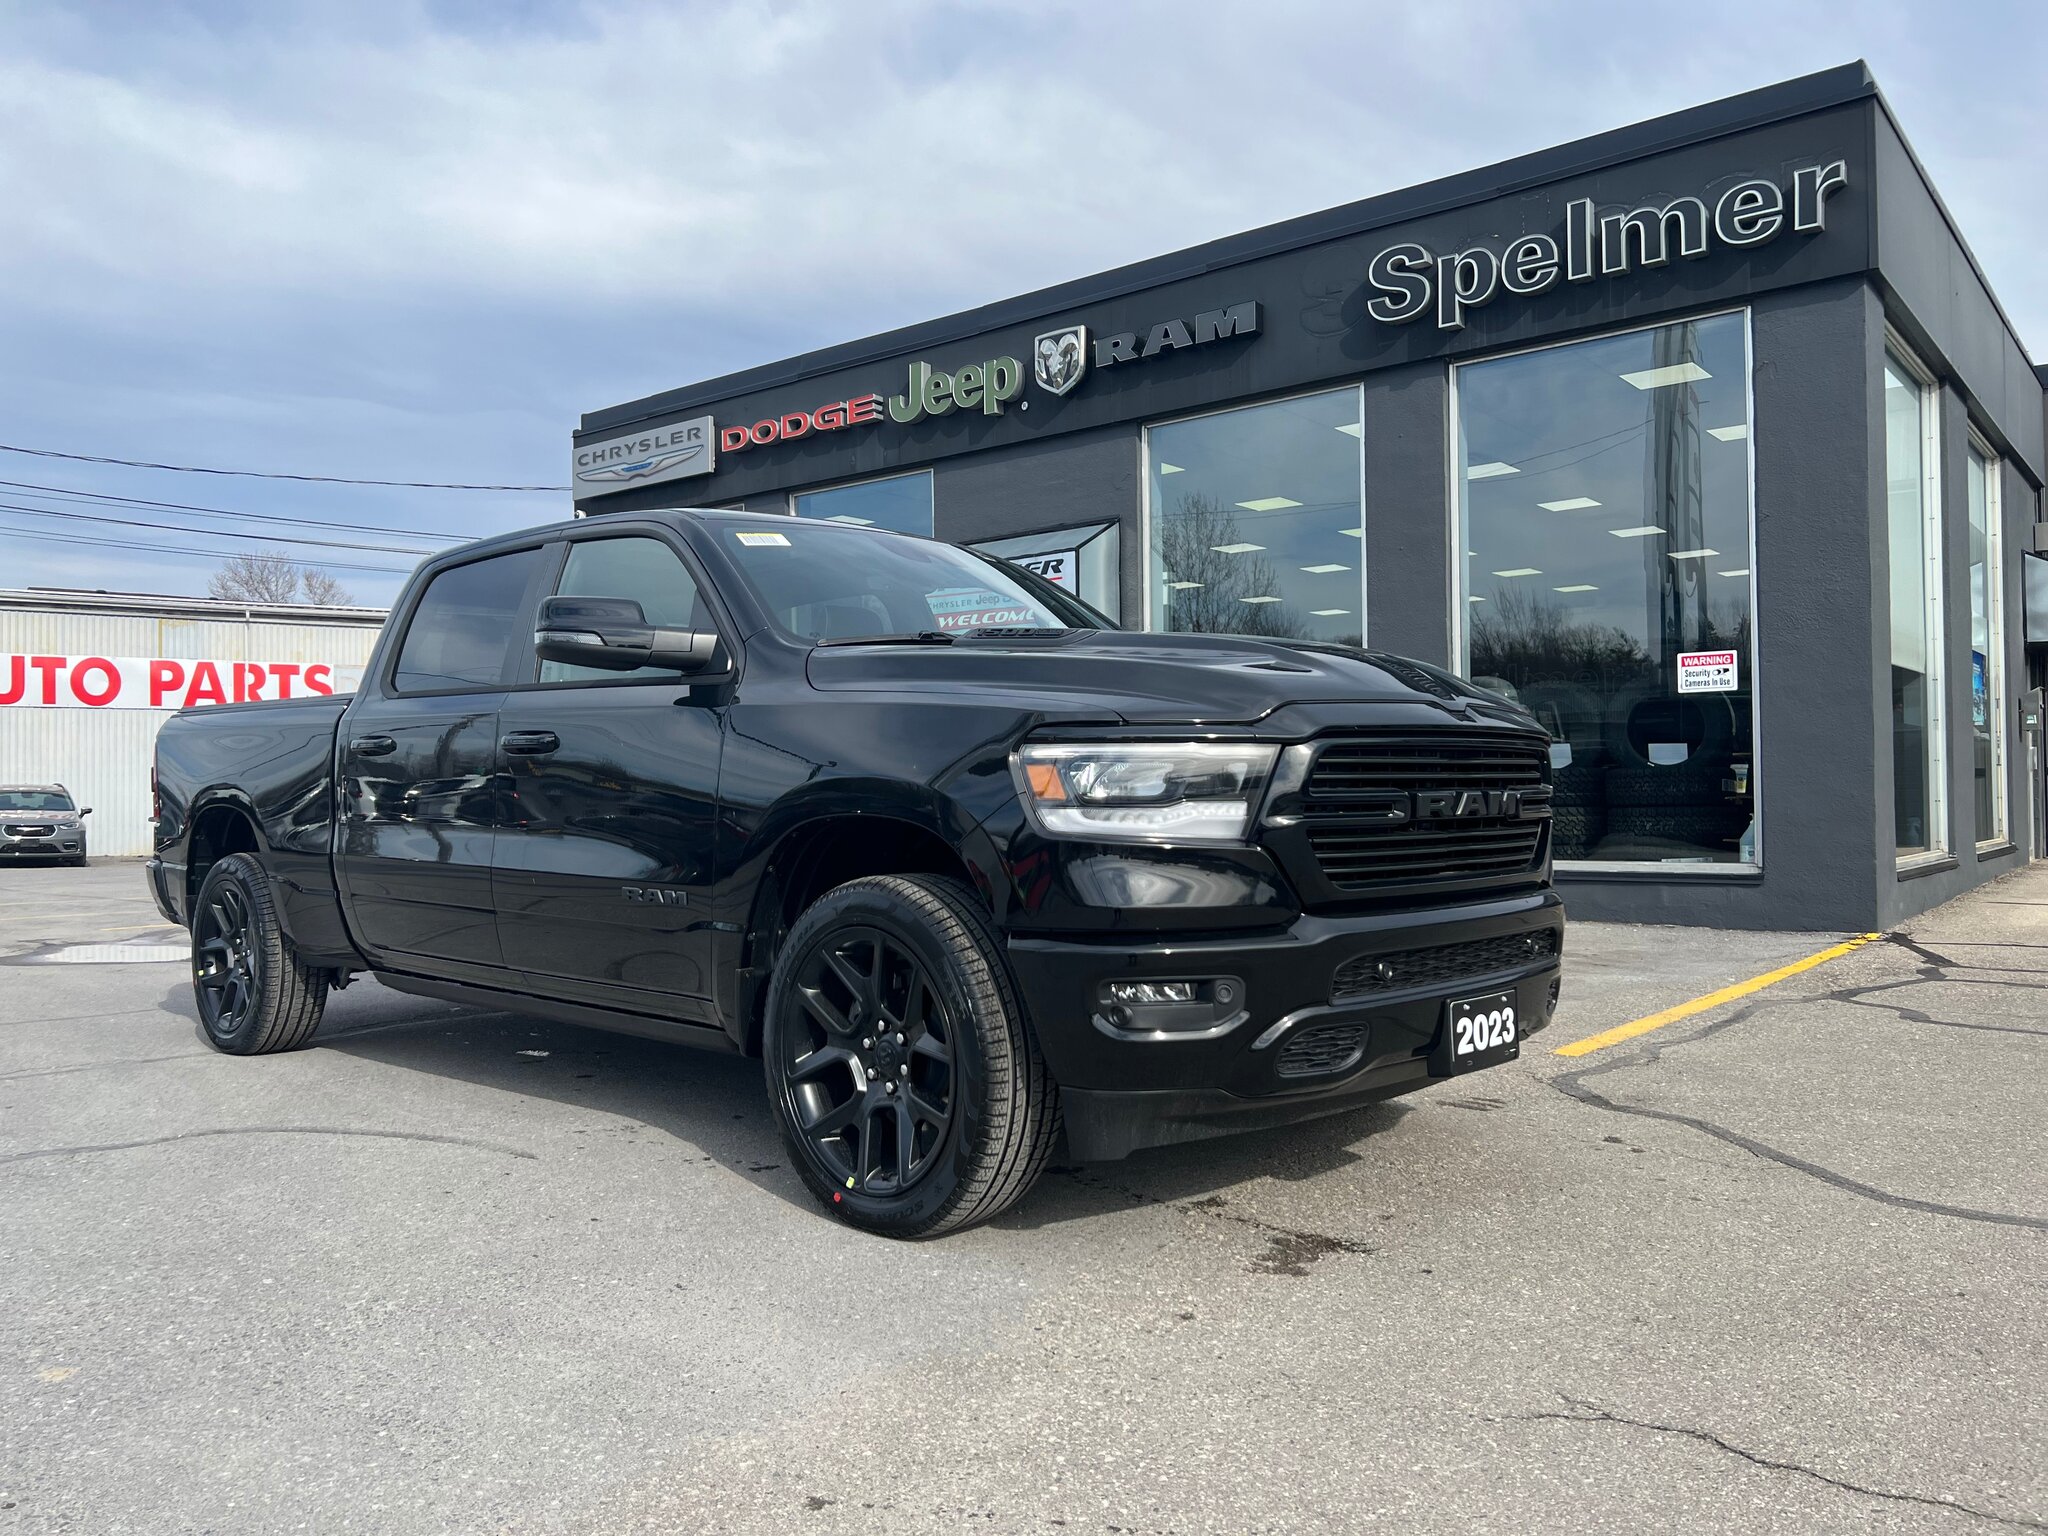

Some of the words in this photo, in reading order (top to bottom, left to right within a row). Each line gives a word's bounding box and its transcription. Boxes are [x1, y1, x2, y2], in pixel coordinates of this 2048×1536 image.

[1367, 158, 1848, 331] Spelmer
[1094, 300, 1262, 368] RAM
[889, 356, 1025, 423] Jeep
[721, 393, 884, 452] DODGE
[577, 427, 703, 467] CHRYSLER
[1020, 559, 1064, 575] ER
[931, 599, 972, 609] HRYSLER
[975, 595, 1000, 605] Jeep
[1683, 655, 1731, 666] WARNING
[1684, 669, 1711, 678] Security
[149, 660, 334, 708] PARTS
[1684, 679, 1711, 688] Cameras
[1711, 678, 1718, 686] In
[1719, 677, 1731, 686] Use
[1416, 790, 1518, 819] RAM
[621, 886, 688, 906] RAM
[1456, 1006, 1515, 1055] 2023
